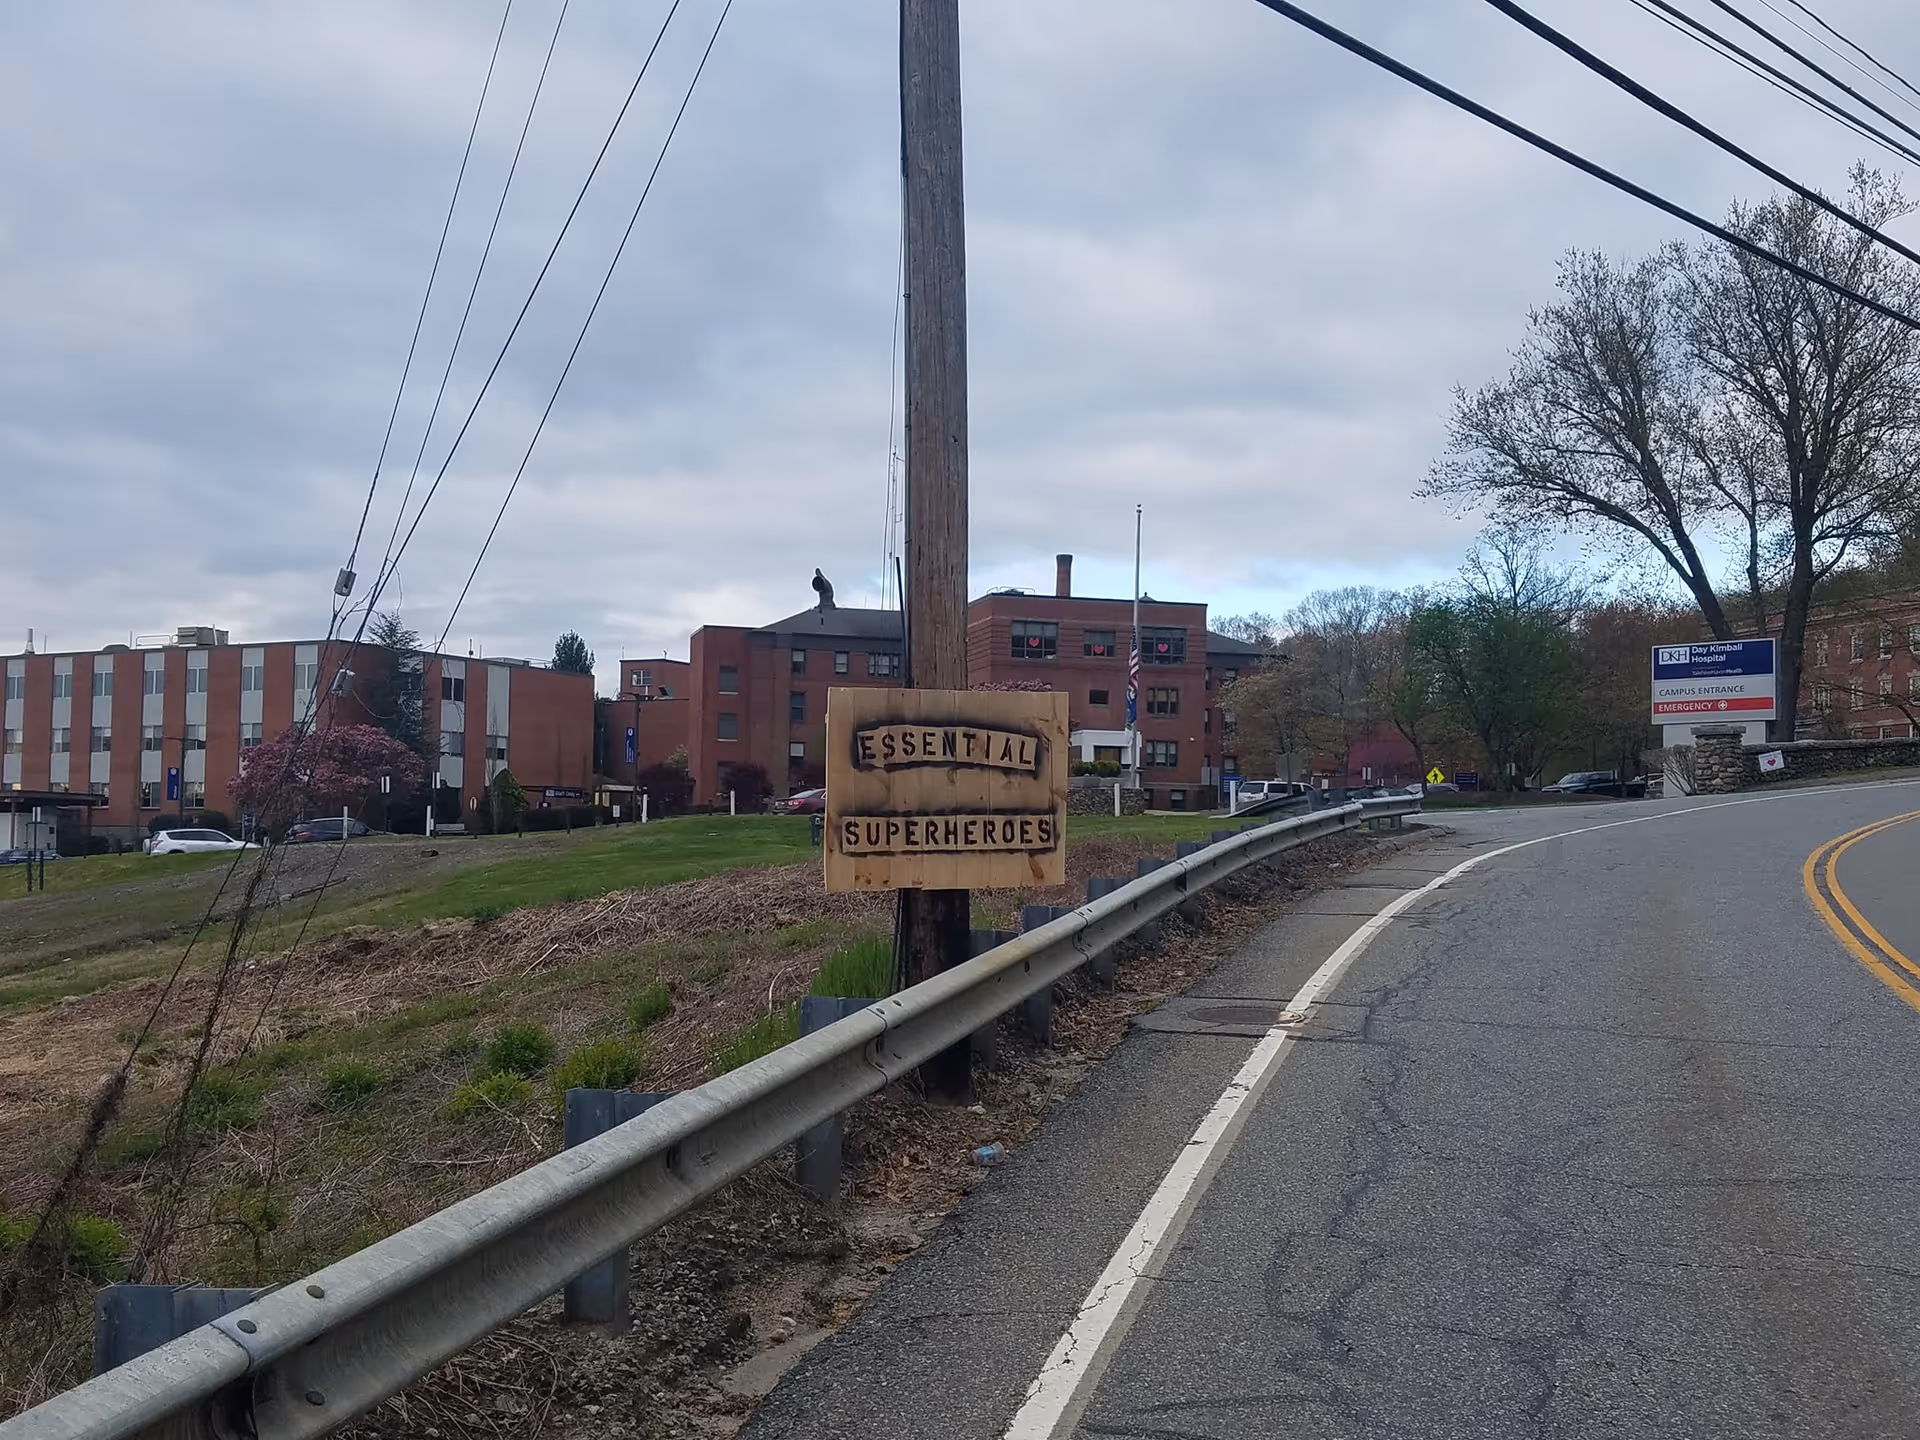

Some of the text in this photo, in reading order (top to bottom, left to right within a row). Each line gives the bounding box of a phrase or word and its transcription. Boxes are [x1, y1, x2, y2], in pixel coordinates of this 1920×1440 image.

[1692, 643, 1743, 655] Day Kimball
[1660, 649, 1688, 663] DKH
[1692, 654, 1726, 664] Hospital
[1659, 685, 1745, 697] CAMPUS ENTRANCE
[1658, 702, 1713, 712] EMERGENCY
[860, 730, 1034, 766] ESSENTIAL
[844, 818, 1051, 847] SUPERHEROES
